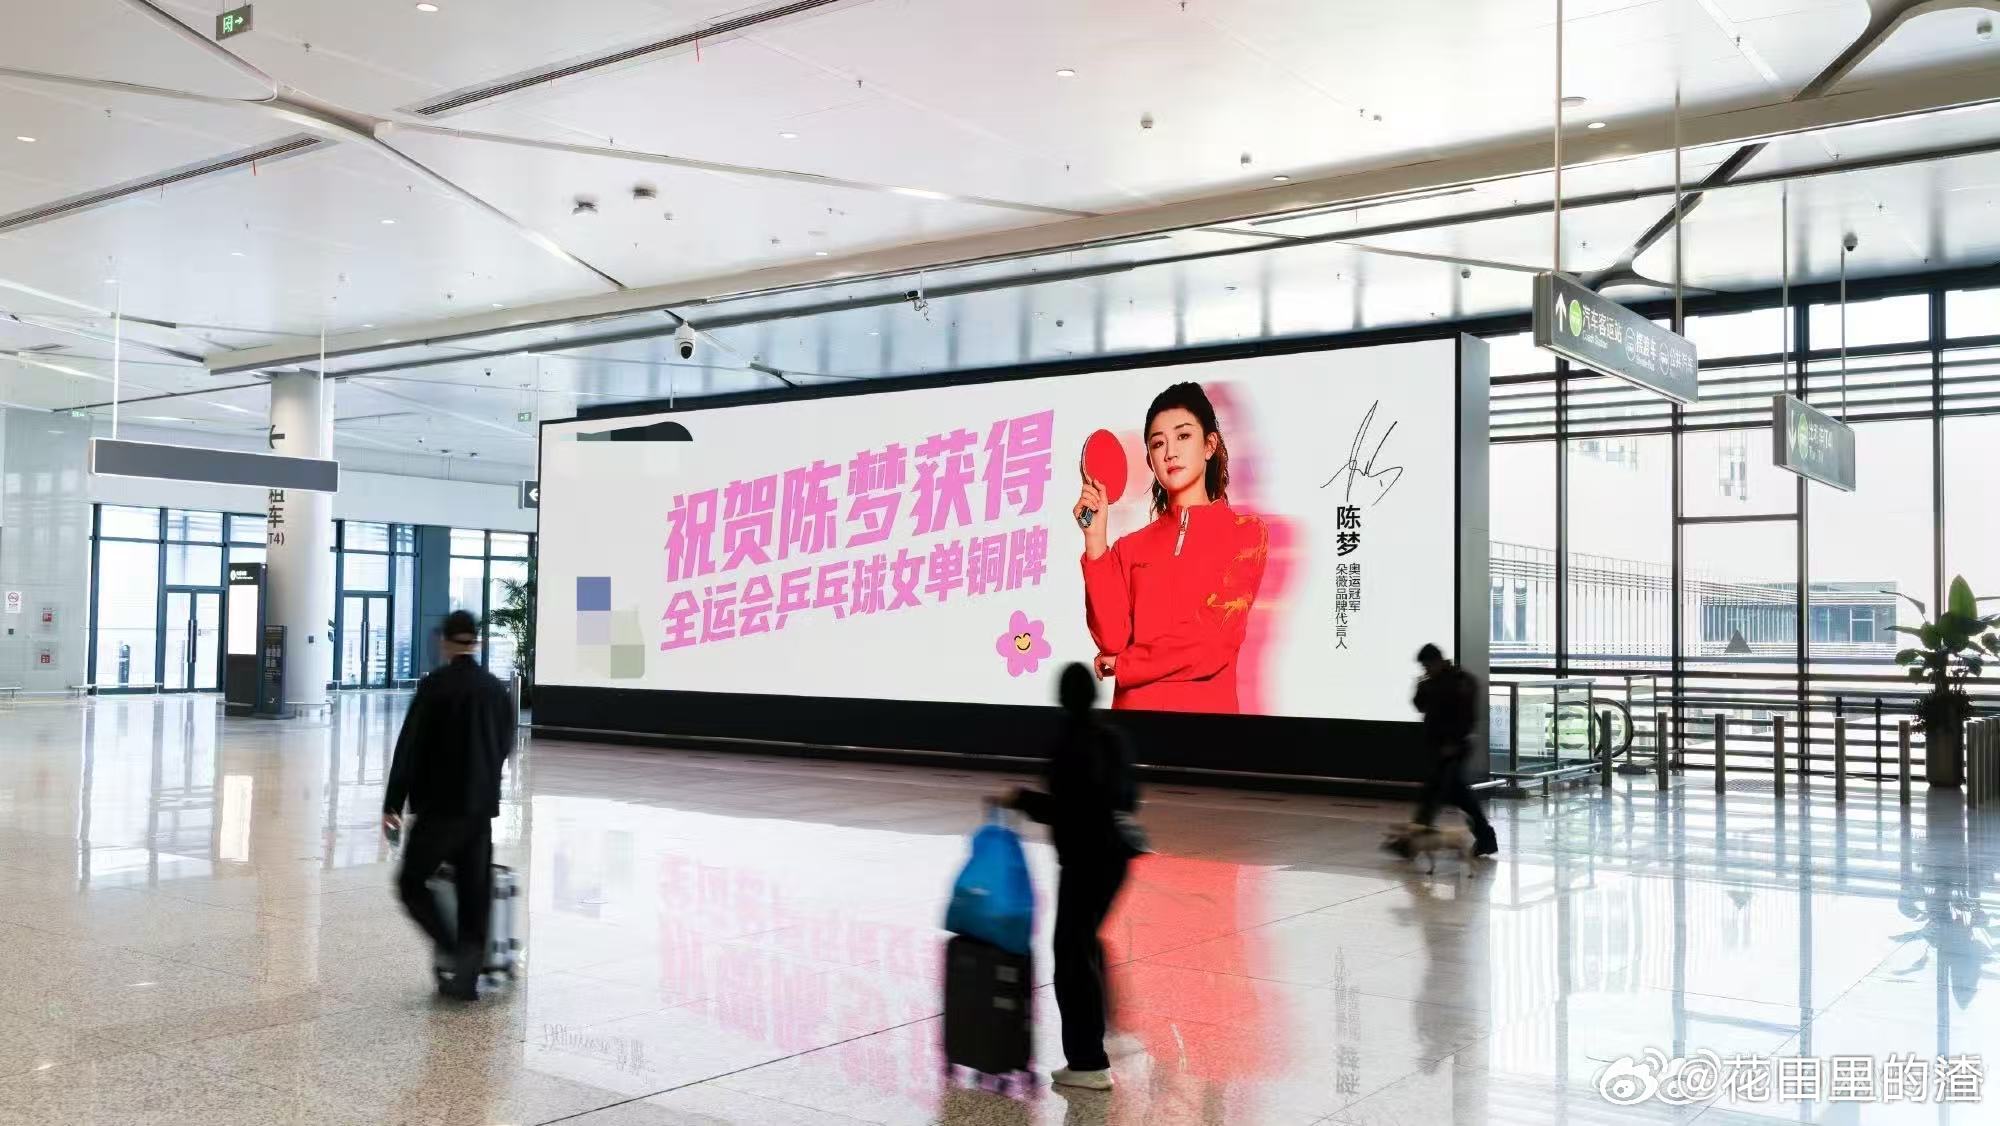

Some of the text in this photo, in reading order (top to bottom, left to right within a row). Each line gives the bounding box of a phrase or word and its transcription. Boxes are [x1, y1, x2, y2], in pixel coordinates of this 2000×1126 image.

[1582, 304, 1622, 343] 汽车客运站
[664, 409, 1055, 583] 祝贺陈梦获得
[1335, 504, 1361, 557] 陈梦
[660, 525, 1049, 652] 全运会乒乓球女单铜牌
[1335, 563, 1348, 650] 朵薇品牌代言人
[1348, 563, 1361, 612] 奥运冠军
